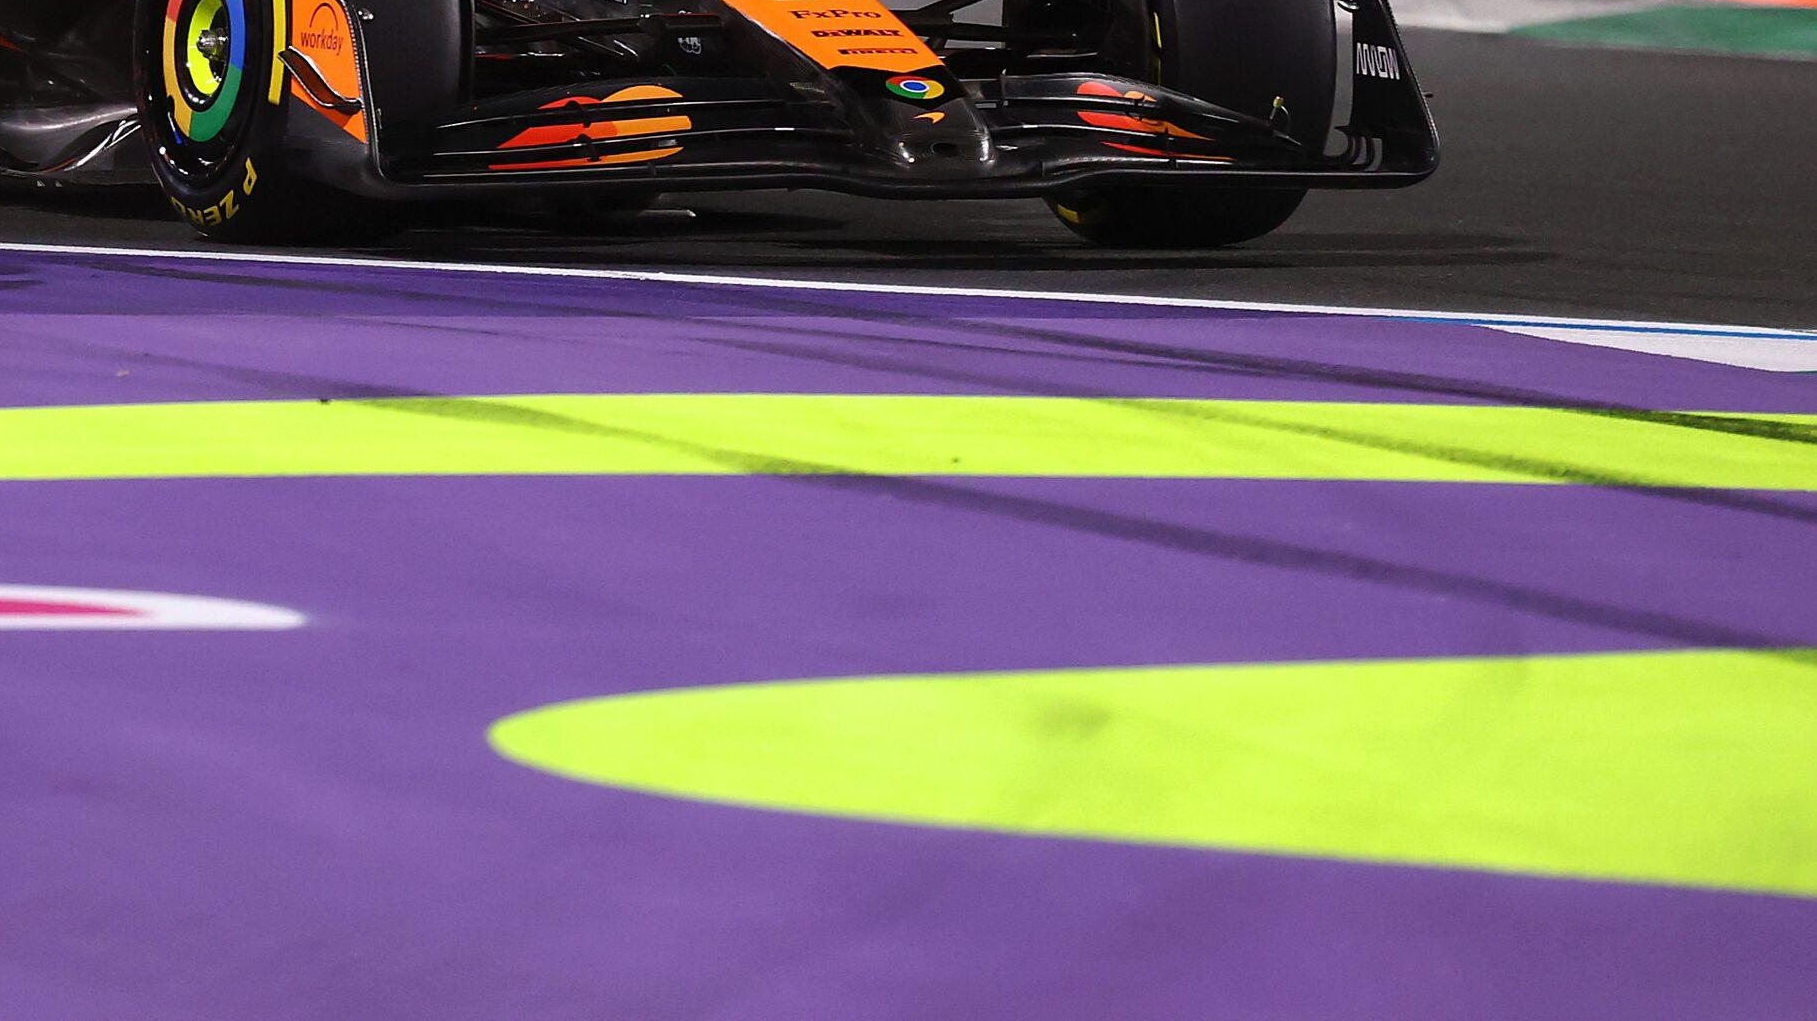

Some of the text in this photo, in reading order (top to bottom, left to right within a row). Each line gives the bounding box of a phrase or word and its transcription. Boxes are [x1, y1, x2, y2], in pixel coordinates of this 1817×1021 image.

[789, 9, 882, 20] FxPro
[300, 28, 344, 56] workday
[242, 156, 258, 196] P
